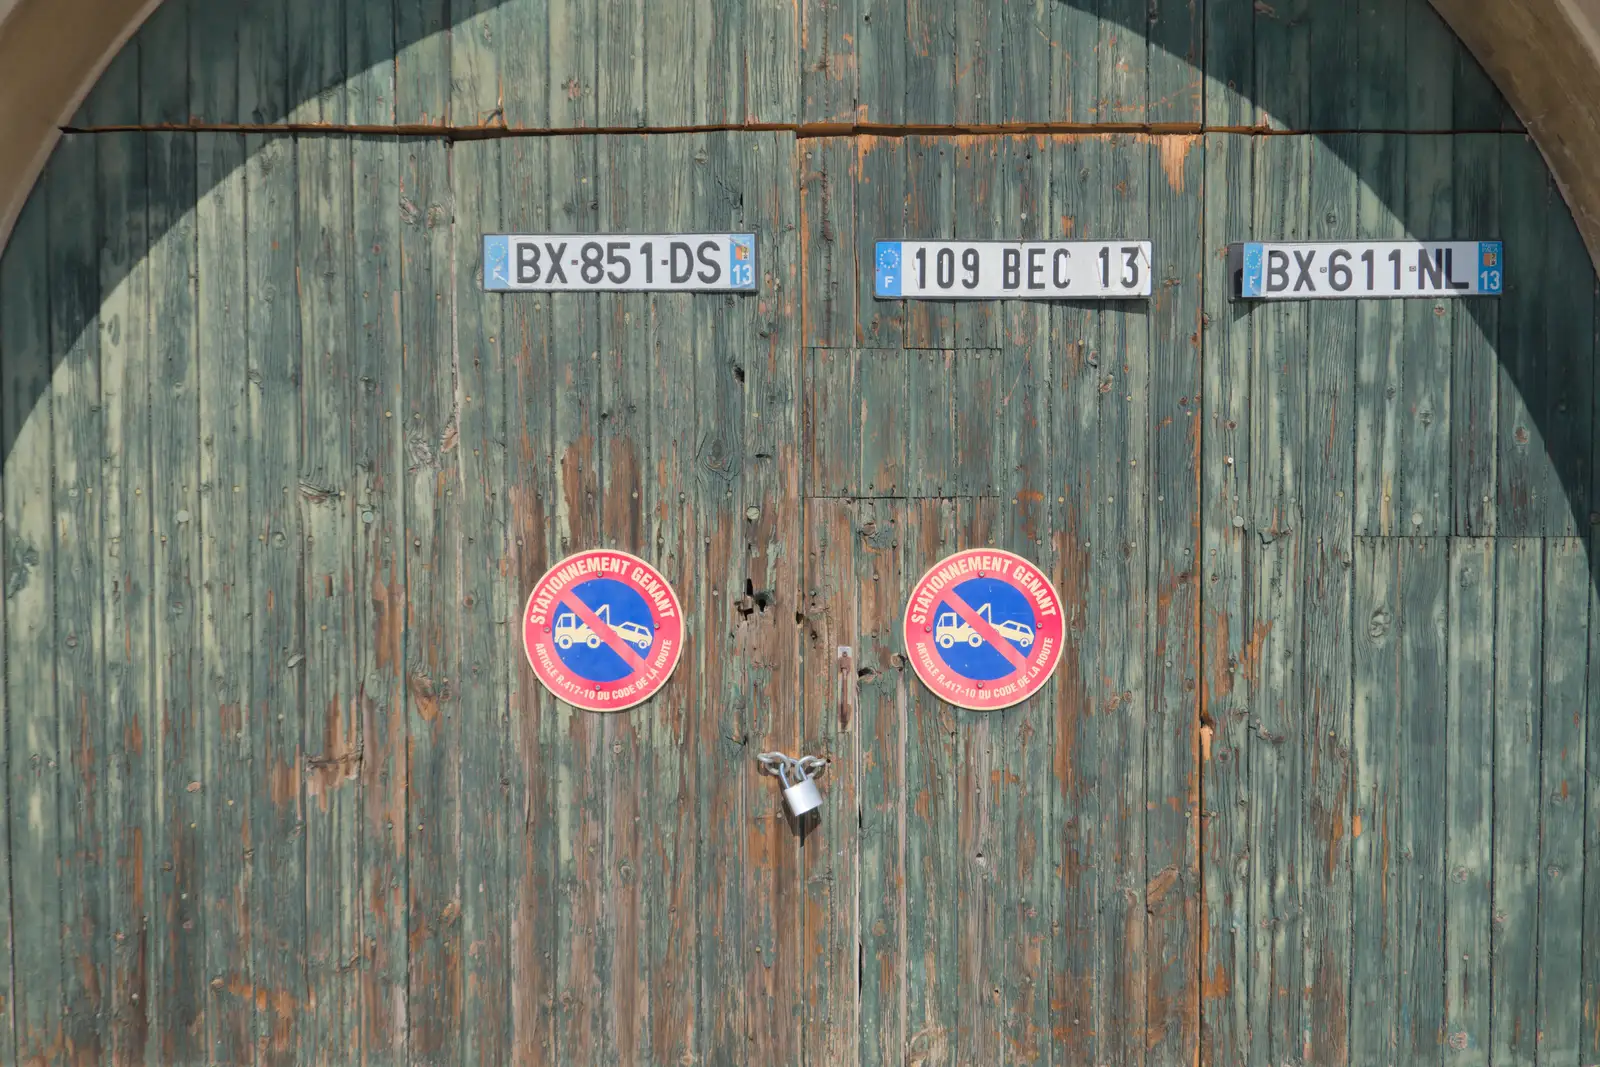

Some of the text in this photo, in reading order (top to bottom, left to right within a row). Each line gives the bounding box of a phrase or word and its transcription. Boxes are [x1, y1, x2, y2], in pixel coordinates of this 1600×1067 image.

[516, 240, 721, 284] BX-851-DS
[733, 264, 753, 285] 13
[884, 276, 894, 288] F
[915, 246, 1139, 289] 109 BEC 13
[1266, 248, 1469, 292] BX-611-NL
[1480, 270, 1500, 290] 13
[530, 557, 675, 625] STATIONNEMENT GENANT
[911, 555, 1056, 624] STATIONNEMENT GENANT
[535, 639, 672, 700] ARTICLE R.417-10 DU CODE DE LA ROUTE
[915, 637, 1054, 699] ARTICLE R.417-10 DU CODE DE LA ROUTE
